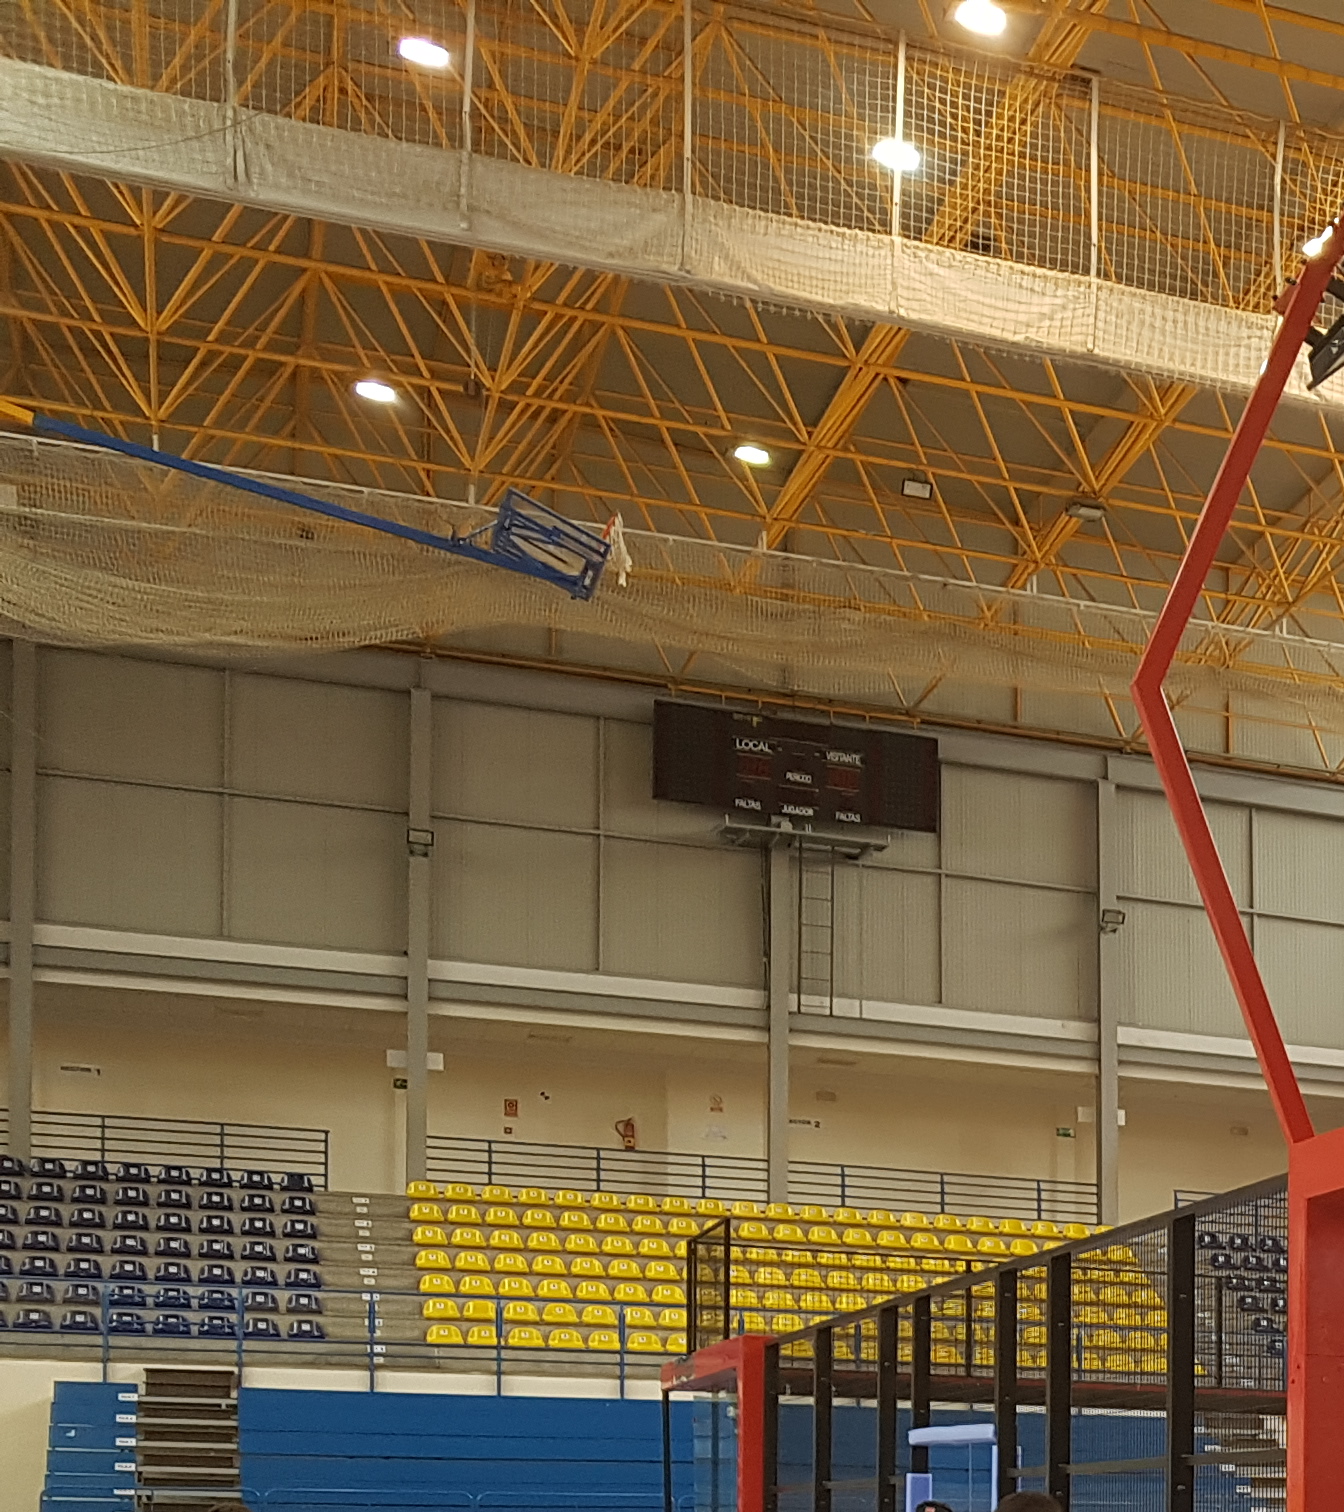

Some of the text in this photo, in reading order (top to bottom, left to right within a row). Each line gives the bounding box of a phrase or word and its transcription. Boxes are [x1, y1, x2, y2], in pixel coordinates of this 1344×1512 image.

[735, 737, 772, 753] LOCAL
[826, 751, 862, 766] VISITANTE
[735, 798, 761, 811] FALTAS
[782, 804, 814, 816] JUGADOR
[835, 810, 861, 823] FALTAS
